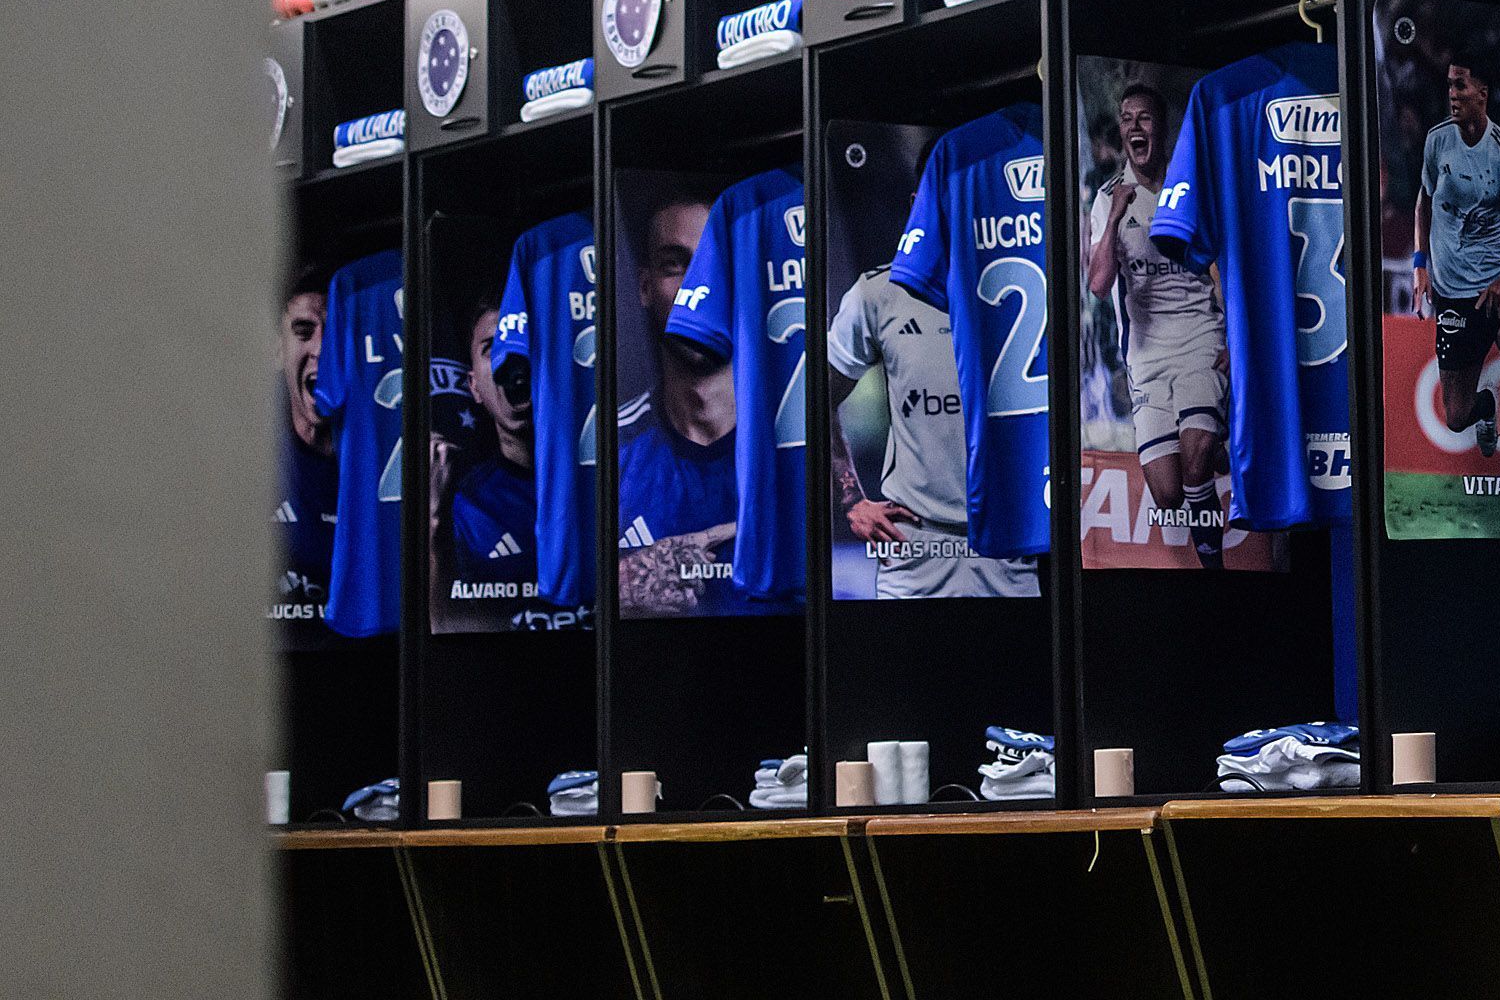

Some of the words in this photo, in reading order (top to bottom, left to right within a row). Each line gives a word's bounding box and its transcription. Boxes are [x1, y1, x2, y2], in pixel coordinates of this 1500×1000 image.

[717, 0, 791, 49] LAUTARO
[1274, 104, 1340, 133] Vilm
[1012, 163, 1045, 191] Vil
[1257, 154, 1342, 192] MARL
[973, 212, 1042, 250] LUCAS
[767, 258, 805, 291] LA
[1288, 197, 1348, 367] 3
[977, 257, 1048, 417] 2
[1149, 508, 1225, 528] MARLON
[866, 541, 924, 559] LUCAS
[451, 580, 518, 599] ÁLVARO
